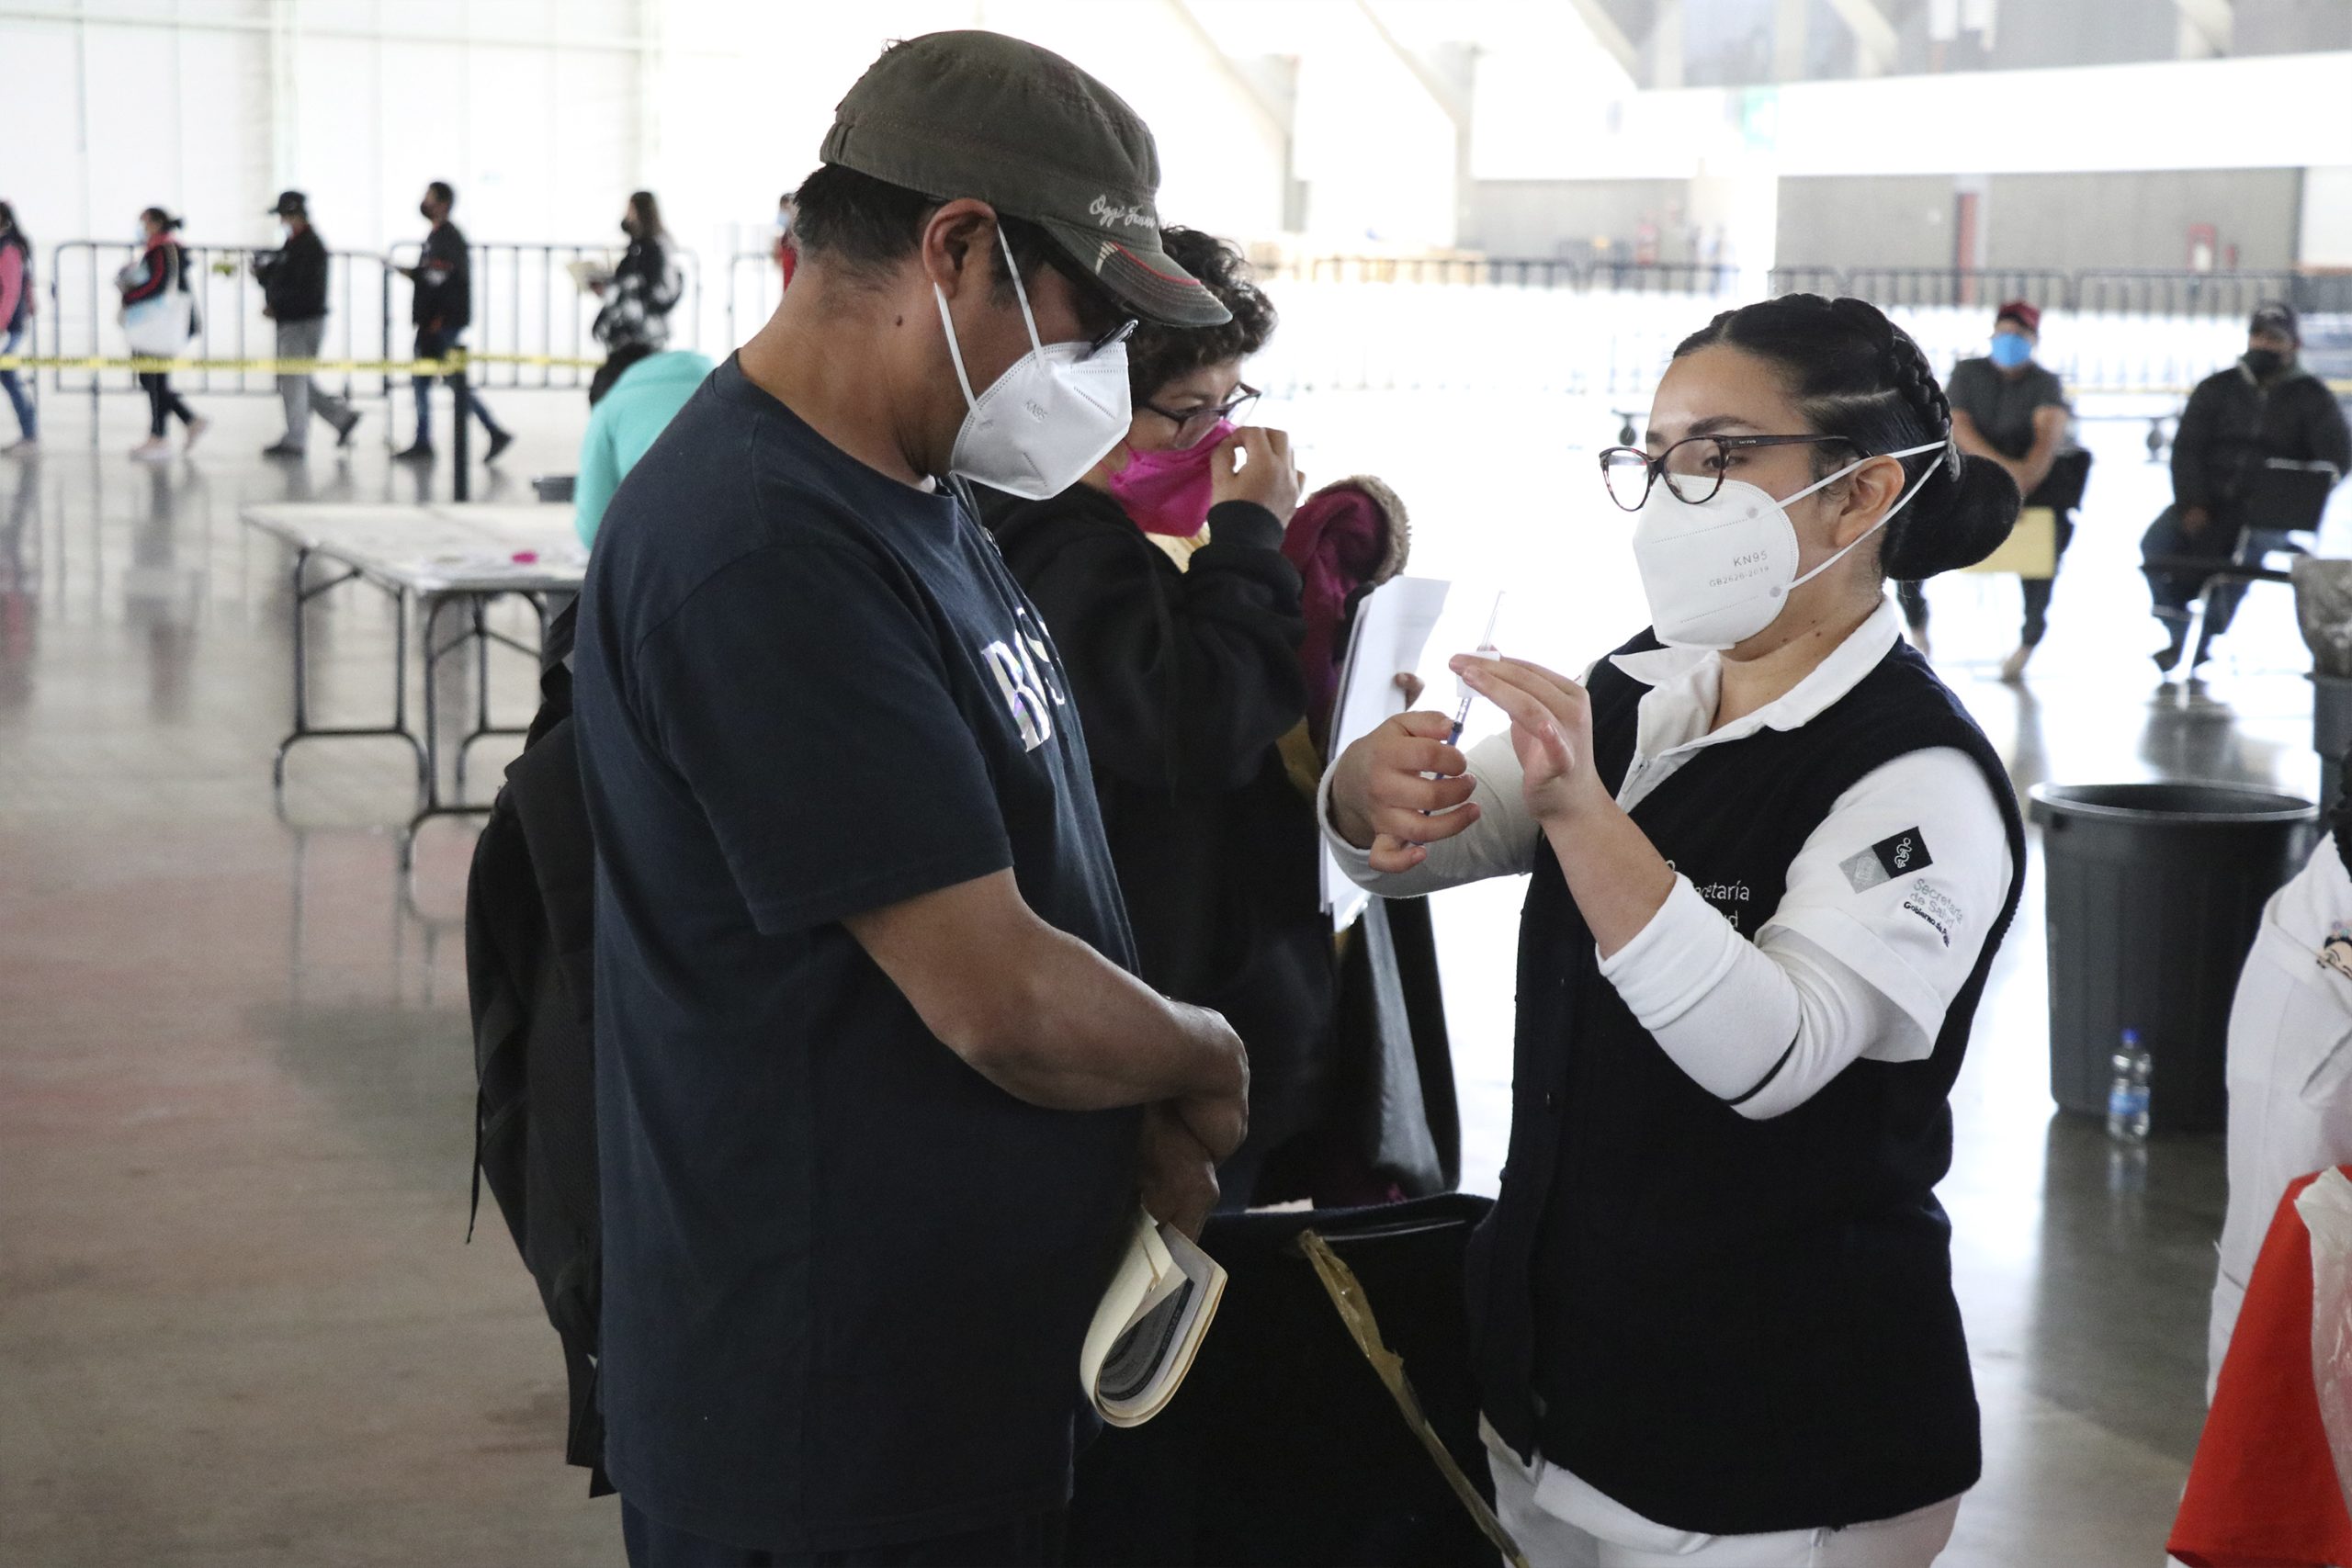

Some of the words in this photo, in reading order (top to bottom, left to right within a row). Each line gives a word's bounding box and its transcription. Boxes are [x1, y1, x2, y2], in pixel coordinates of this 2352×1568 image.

[1089, 194, 1125, 228] Oggi
[1733, 550, 1769, 567] KN95
[1910, 892, 1926, 906] de
